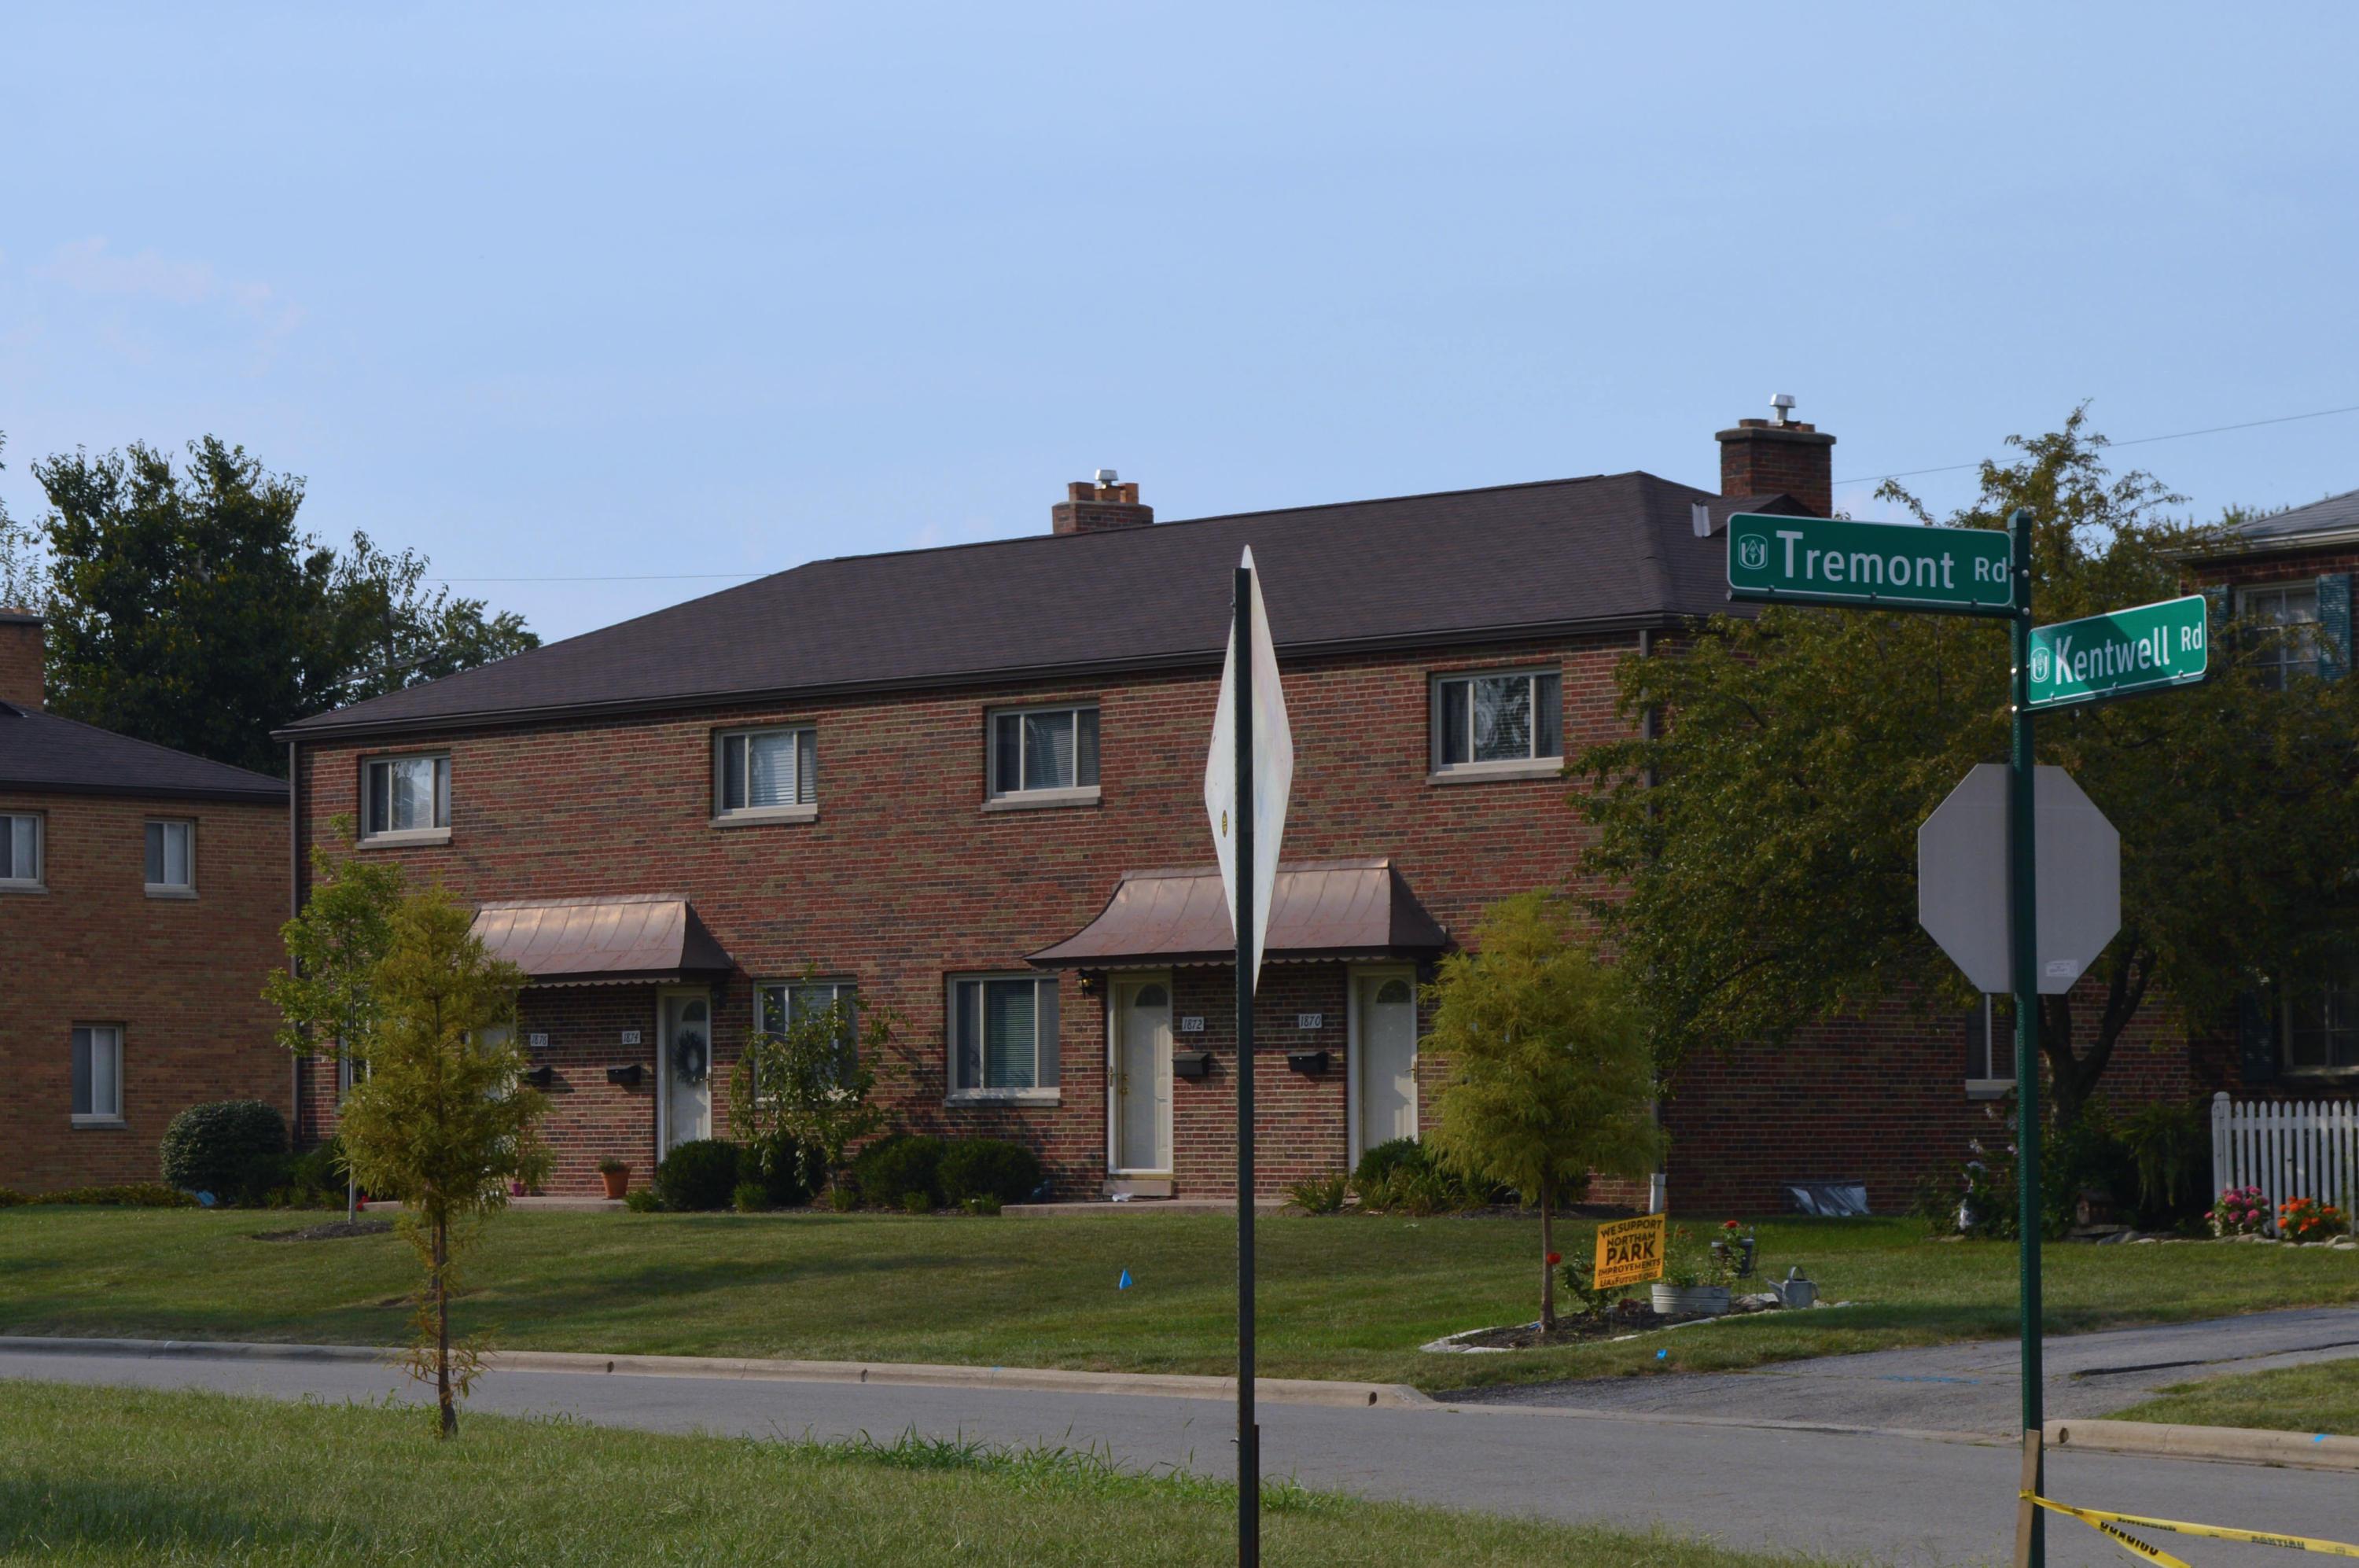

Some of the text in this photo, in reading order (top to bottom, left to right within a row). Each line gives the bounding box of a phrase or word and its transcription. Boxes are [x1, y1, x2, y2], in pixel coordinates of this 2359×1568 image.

[1776, 530, 1955, 590] Tremont
[1974, 556, 2008, 584] Rd
[2055, 624, 2170, 686] Kentwell
[2181, 620, 2203, 653] Rd
[1183, 1018, 1202, 1030] 1872
[1301, 1015, 1321, 1027] 1870
[623, 1032, 639, 1043] 1874
[1601, 1219, 1662, 1239] WE SUPPORT
[1606, 1231, 1656, 1247] NORTHAM
[1606, 1239, 1655, 1266] PARK
[1598, 1258, 1661, 1277] IMPROVEMENTS
